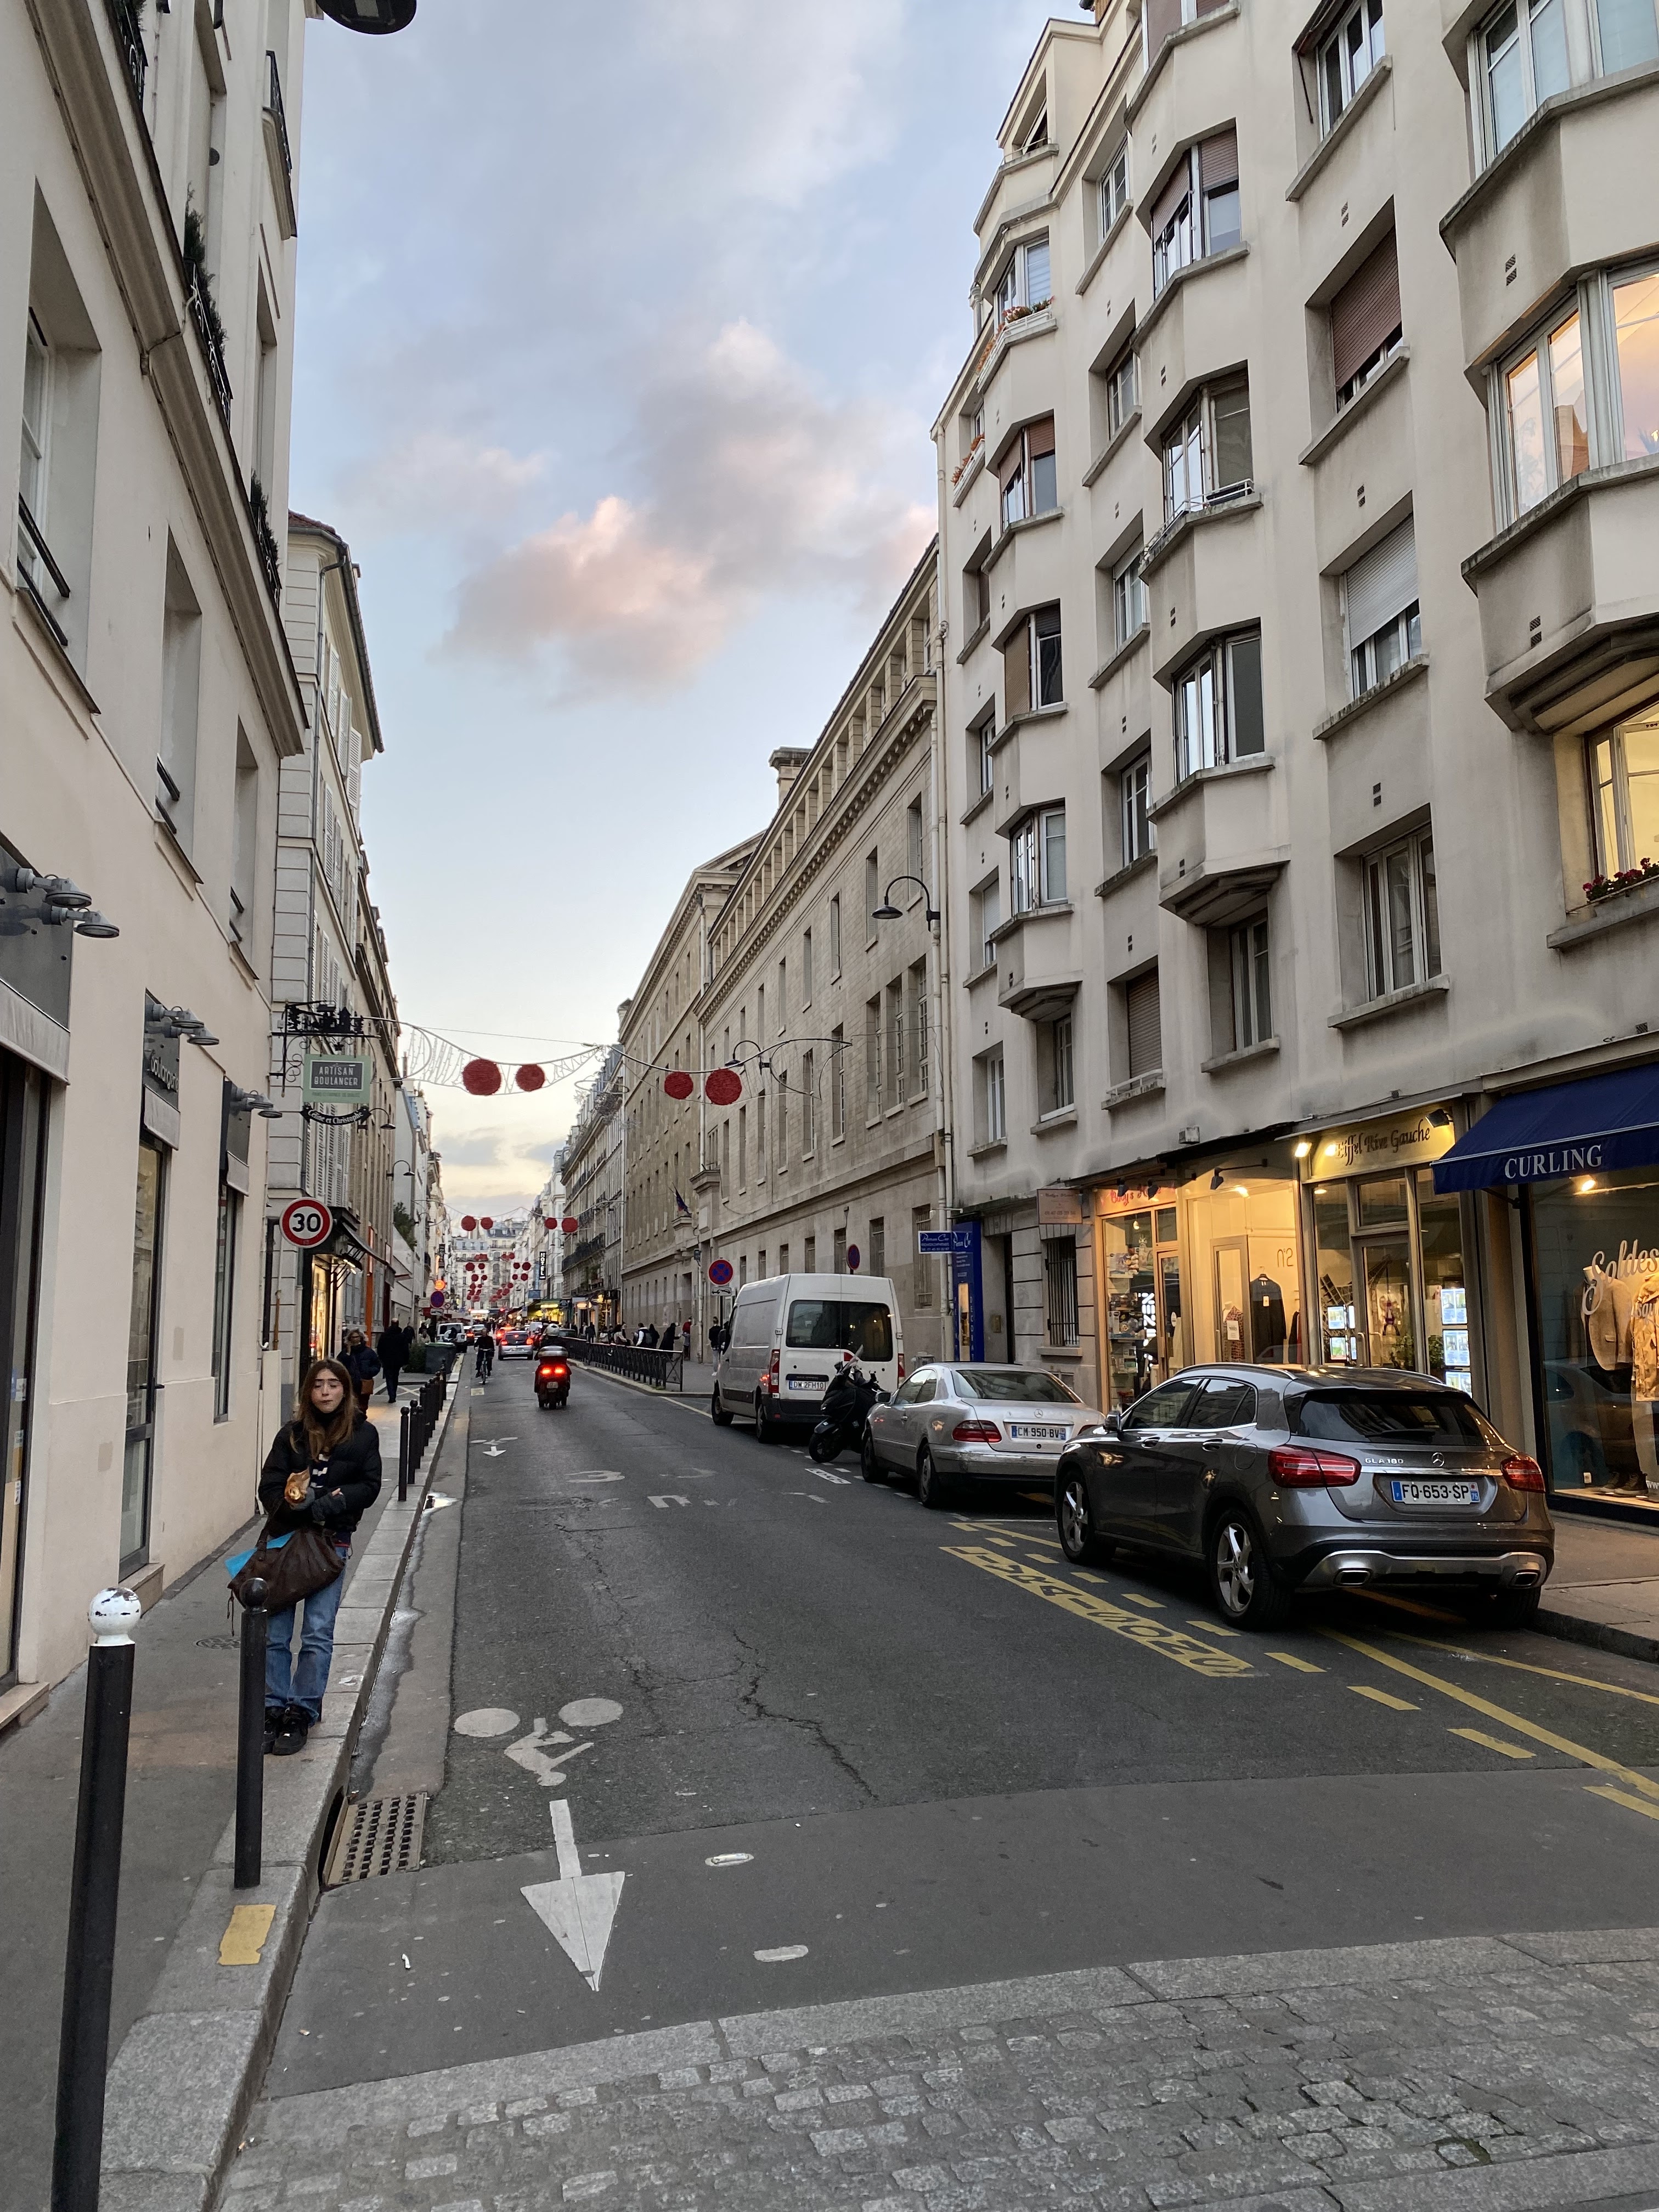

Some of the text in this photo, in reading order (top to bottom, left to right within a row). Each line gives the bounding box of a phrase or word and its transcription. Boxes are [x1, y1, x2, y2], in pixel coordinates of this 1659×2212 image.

[319, 1066, 354, 1076] ARTISAN
[314, 1076, 358, 1086] BOULANGER
[332, 1111, 364, 1125] Christophe
[1364, 1133, 1389, 1153] Rive
[1390, 1119, 1430, 1153] Gauche
[1504, 1144, 1602, 1180] CURLING
[292, 1213, 321, 1232] 30
[1582, 1239, 1659, 1315] Soldes
[1018, 1427, 1059, 1438] CM-950-BV
[1402, 1484, 1469, 1499] FQ-653-SP
[1471, 1492, 1479, 1500] 75
